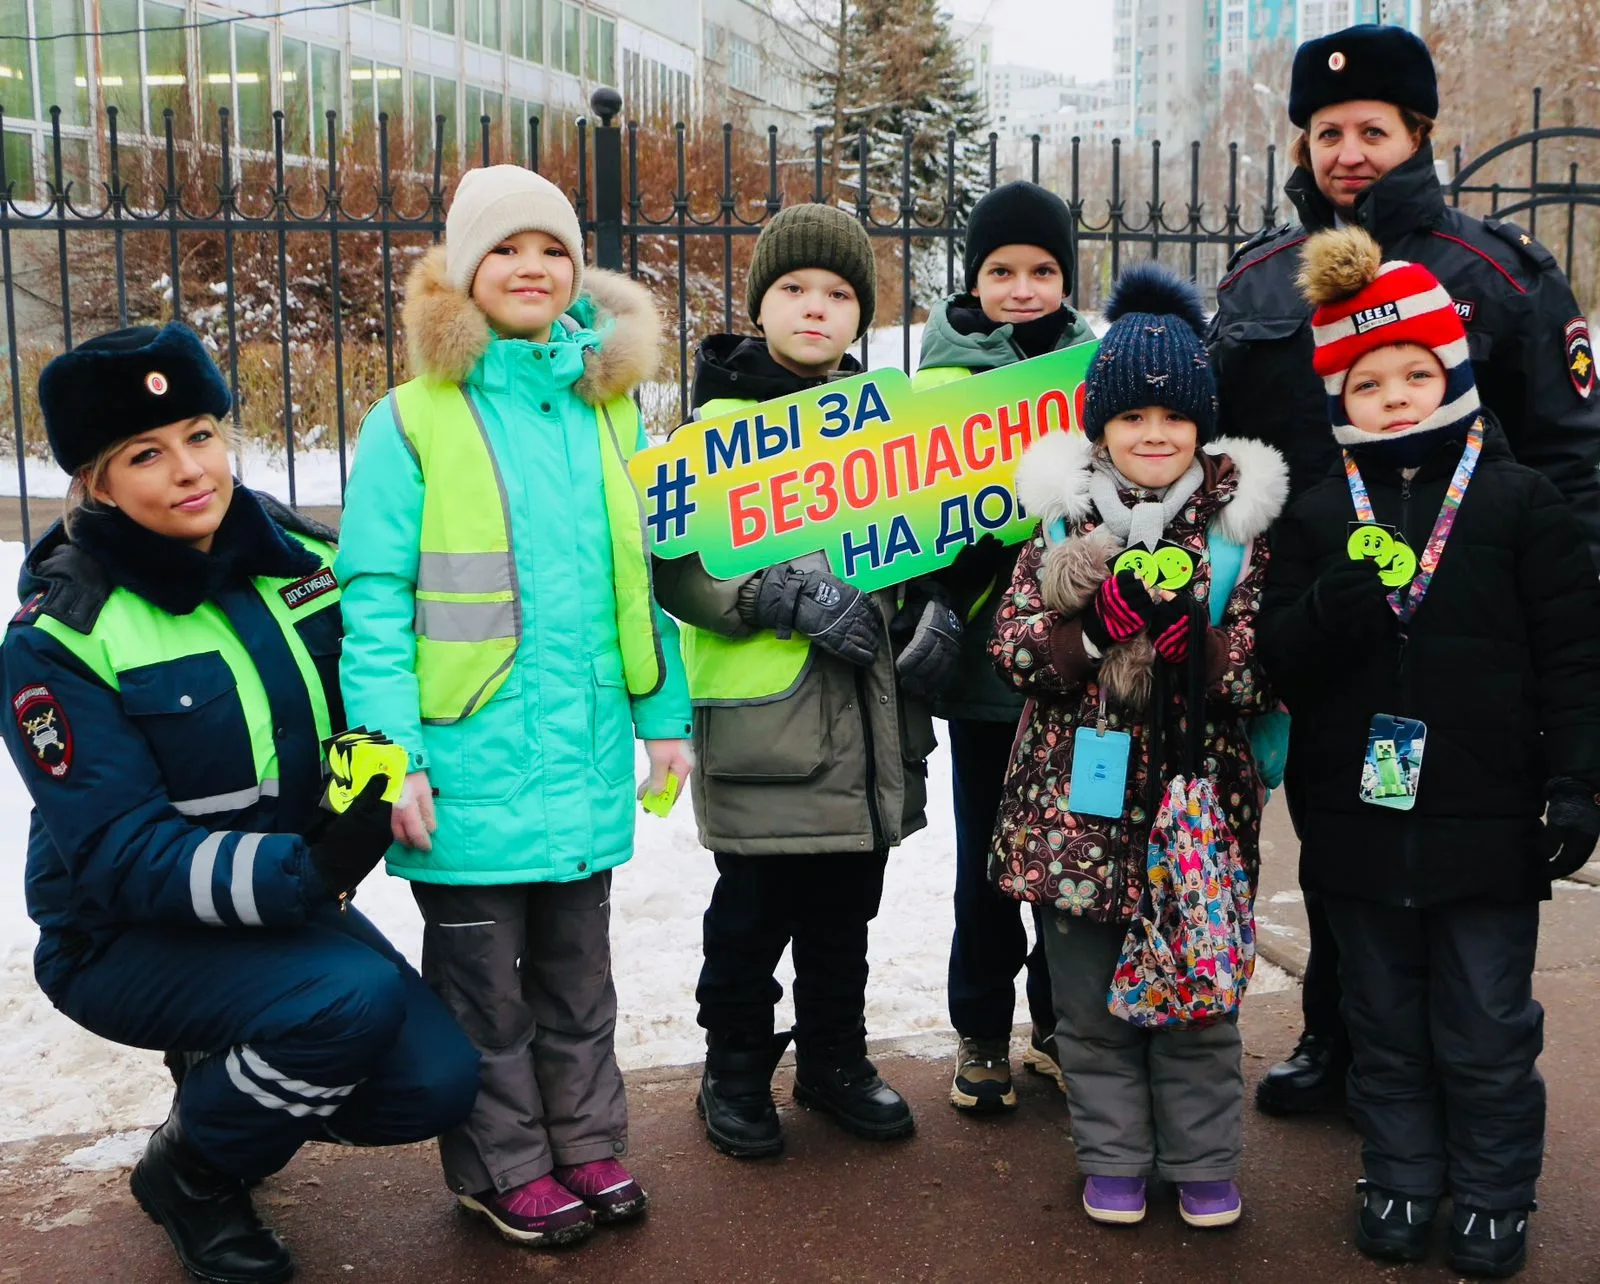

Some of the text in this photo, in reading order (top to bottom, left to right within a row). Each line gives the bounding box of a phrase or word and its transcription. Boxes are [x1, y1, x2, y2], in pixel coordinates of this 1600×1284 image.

[1355, 303, 1394, 325] KEEP
[705, 404, 801, 475] МЫ
[817, 382, 891, 439] ЗА
[842, 485, 1027, 577] НА ДО
